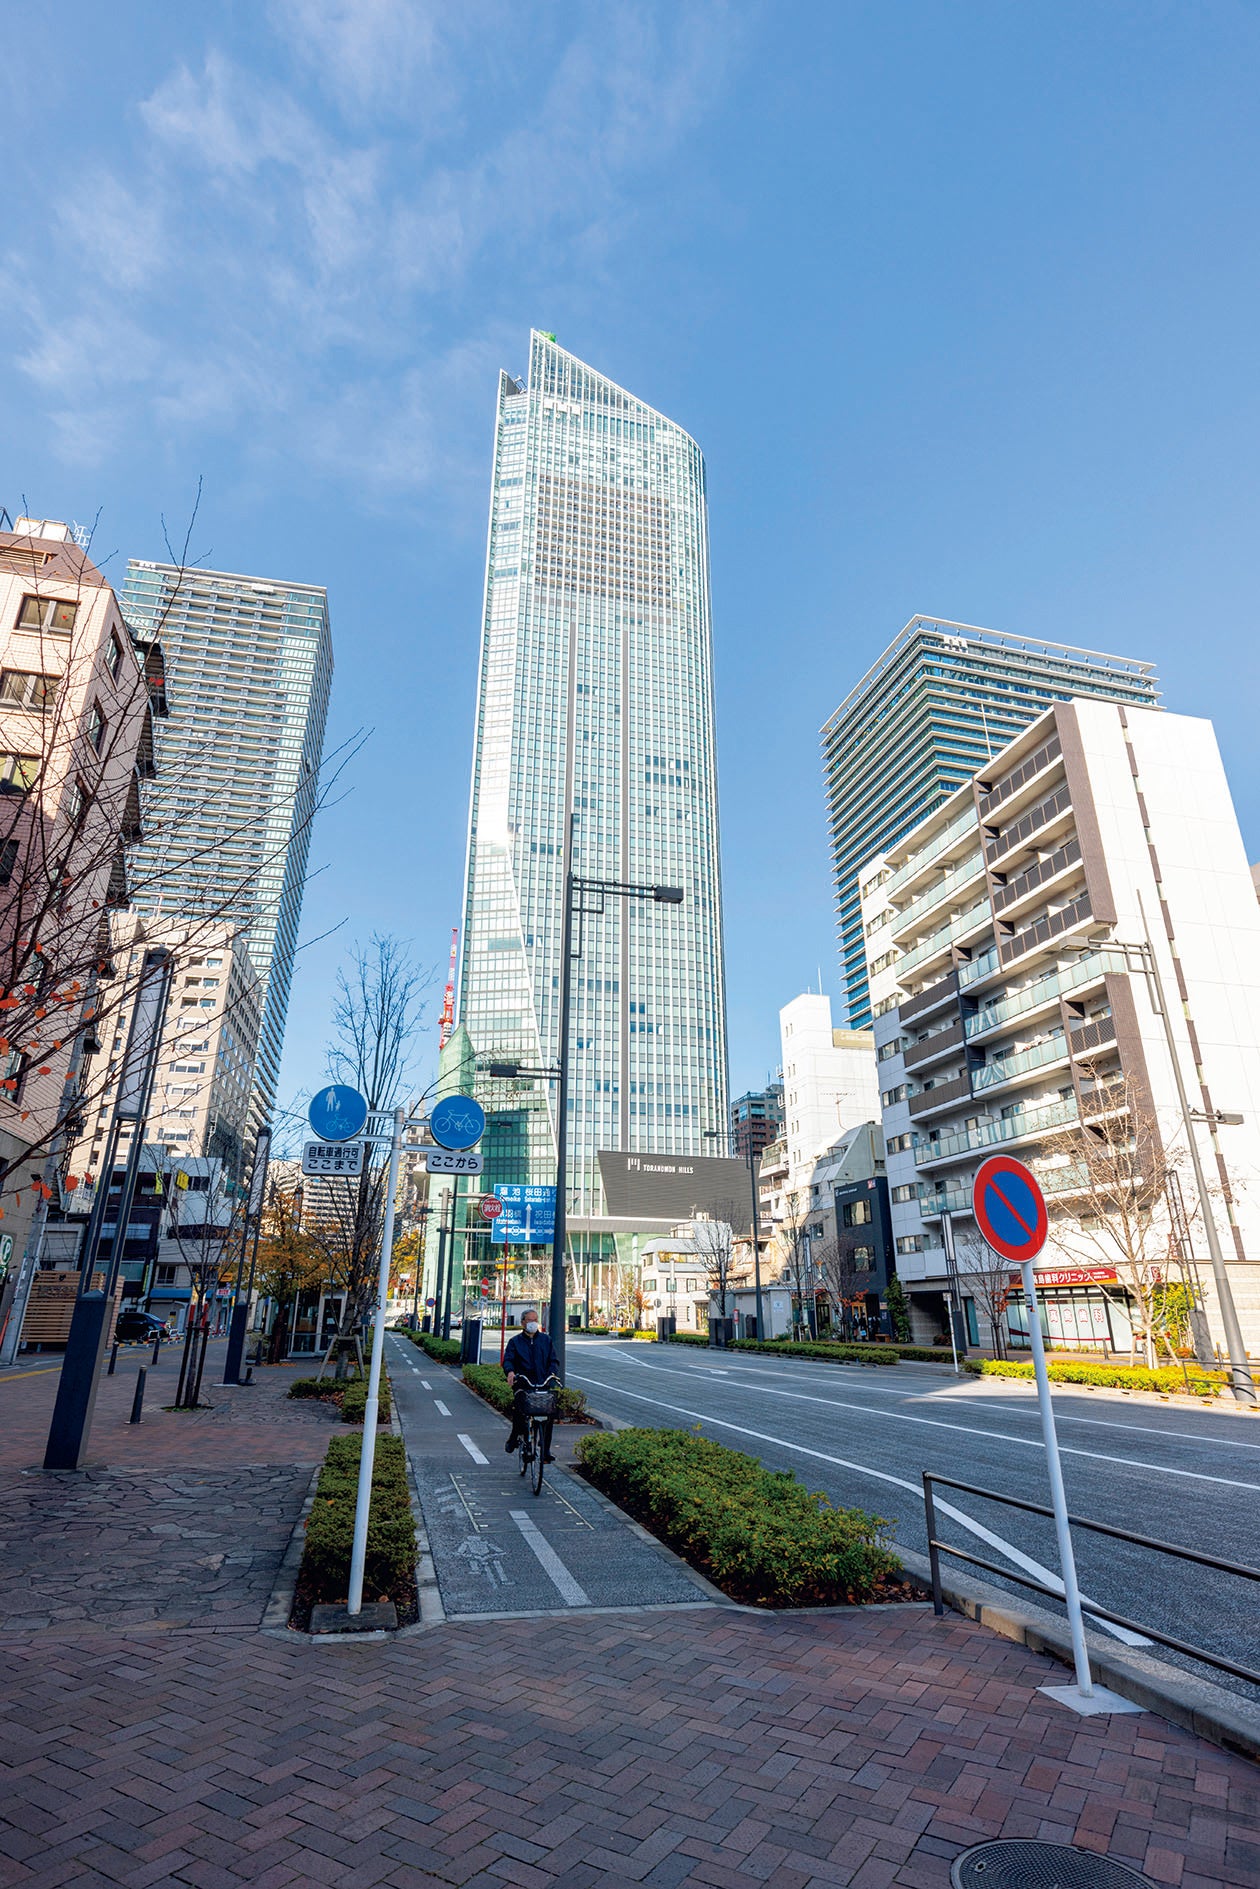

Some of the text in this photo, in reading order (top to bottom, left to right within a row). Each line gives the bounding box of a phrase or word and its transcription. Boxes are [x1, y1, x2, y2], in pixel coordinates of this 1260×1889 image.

[308, 1146, 360, 1159] 自転車通行可
[308, 1159, 358, 1171] ここまで
[431, 1155, 479, 1170] ここから
[643, 1164, 694, 1175] TORANOMON HILLS
